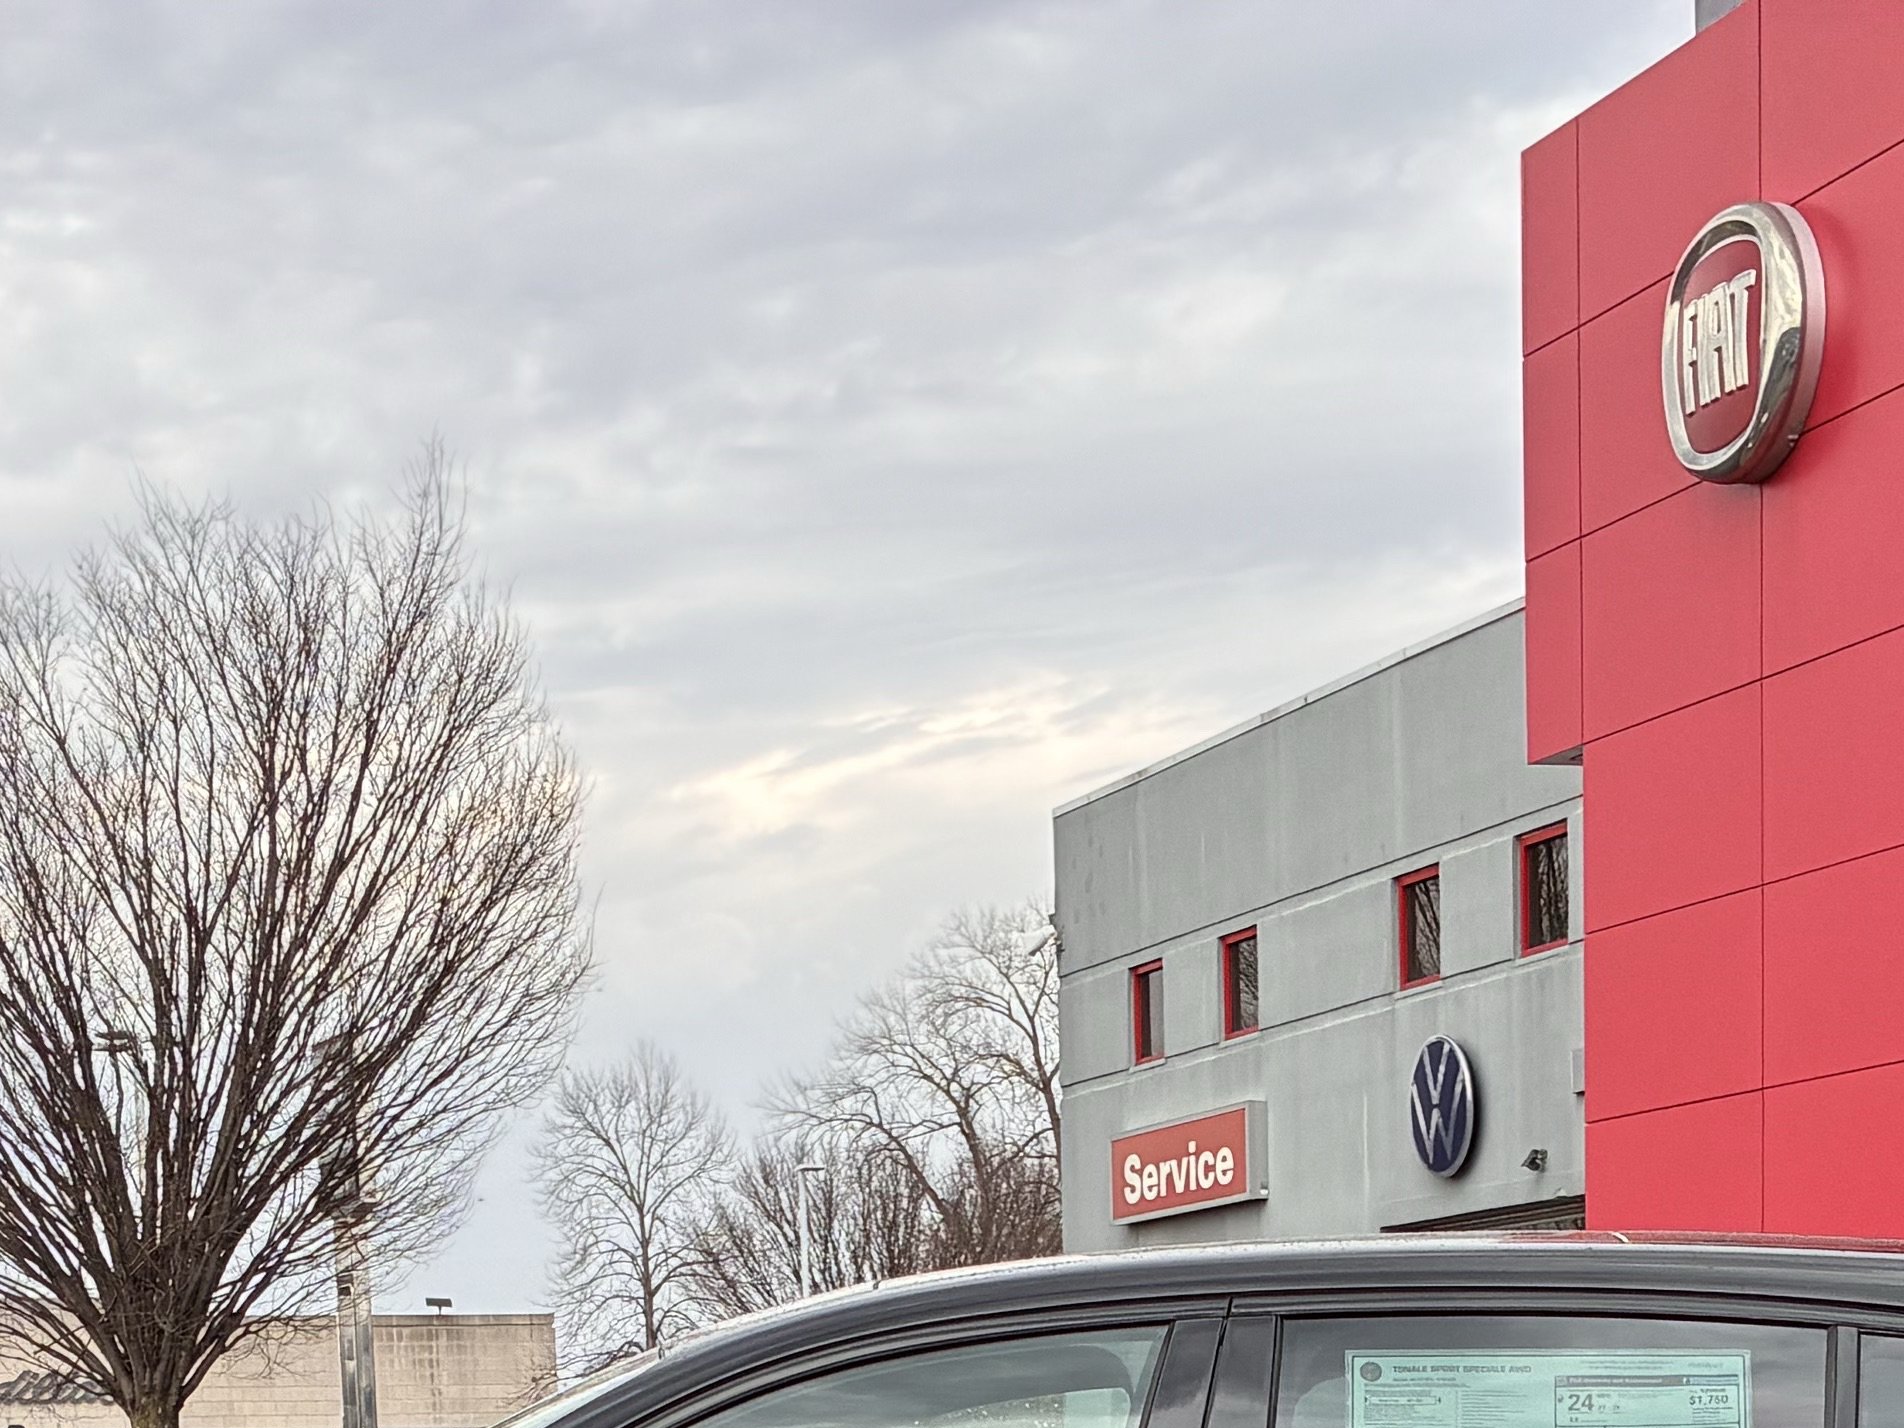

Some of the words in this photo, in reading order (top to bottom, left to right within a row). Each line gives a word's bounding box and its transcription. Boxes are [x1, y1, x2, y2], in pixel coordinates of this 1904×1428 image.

[1682, 269, 1757, 416] FIAT
[1123, 1140, 1235, 1205] Service
[1568, 1393, 1594, 1412] 24
